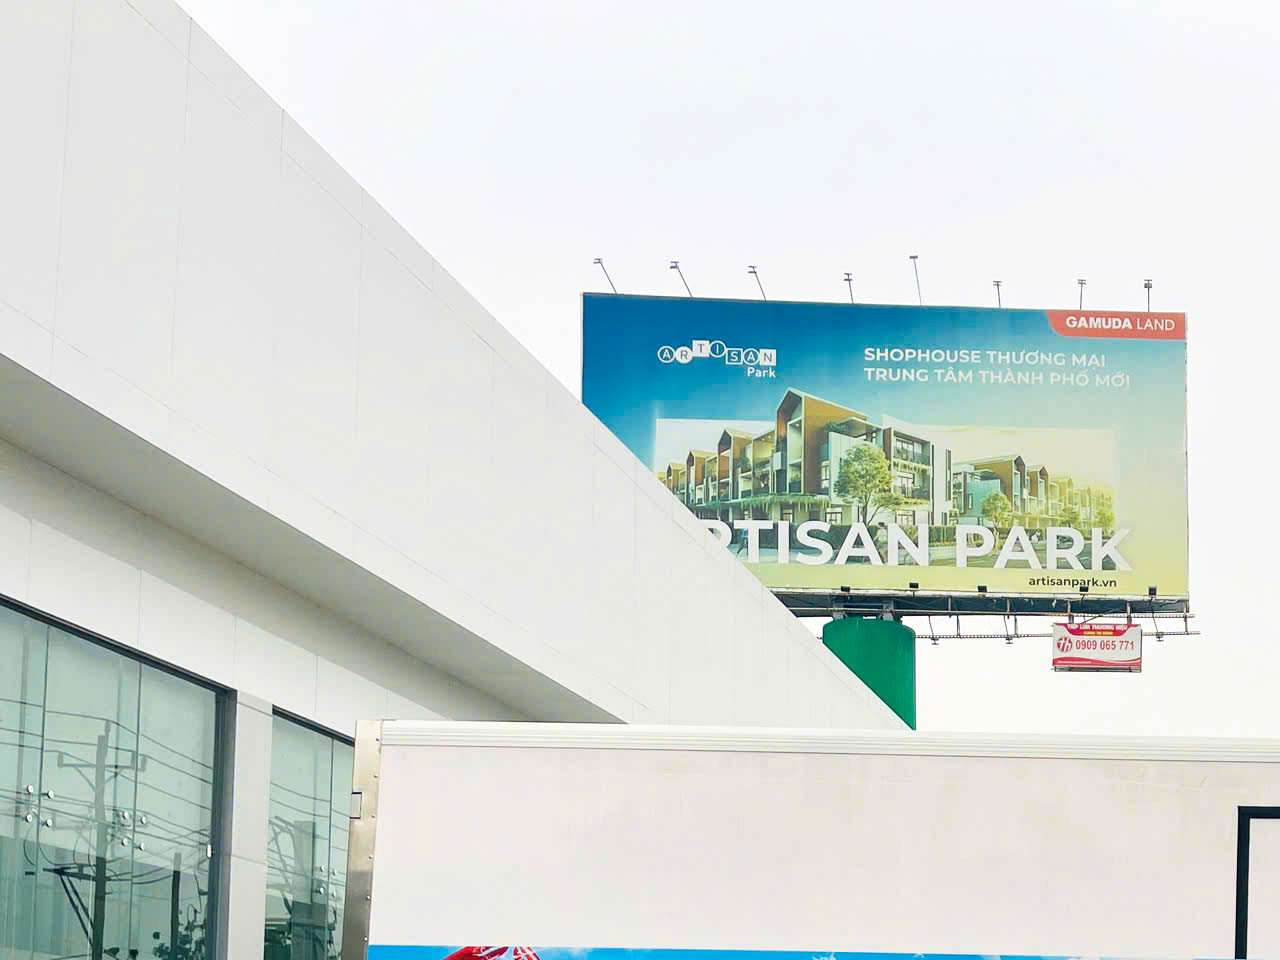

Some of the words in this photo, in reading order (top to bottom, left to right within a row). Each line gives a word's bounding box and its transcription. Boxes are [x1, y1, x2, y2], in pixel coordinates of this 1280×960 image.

[1065, 316, 1133, 330] GAMUDA
[1136, 318, 1175, 331] LAND
[658, 339, 777, 366] ARTISAN
[864, 347, 981, 364] SHOPHOUSE
[985, 349, 1066, 367] THƯƠNG
[1071, 352, 1106, 371] MẠI
[747, 366, 776, 378] Park
[863, 367, 929, 383] TRUNG
[934, 366, 973, 385] TÂM
[978, 367, 1044, 386] THÀNH
[1049, 369, 1091, 388] PHỐ
[1095, 371, 1131, 389] MỚI
[697, 518, 930, 567] TISAN
[955, 524, 1135, 572] PARK
[1028, 574, 1118, 589] artisanpark.vn
[1075, 639, 1098, 650] 0909
[1100, 639, 1117, 650] 065
[1119, 640, 1135, 651] 771
